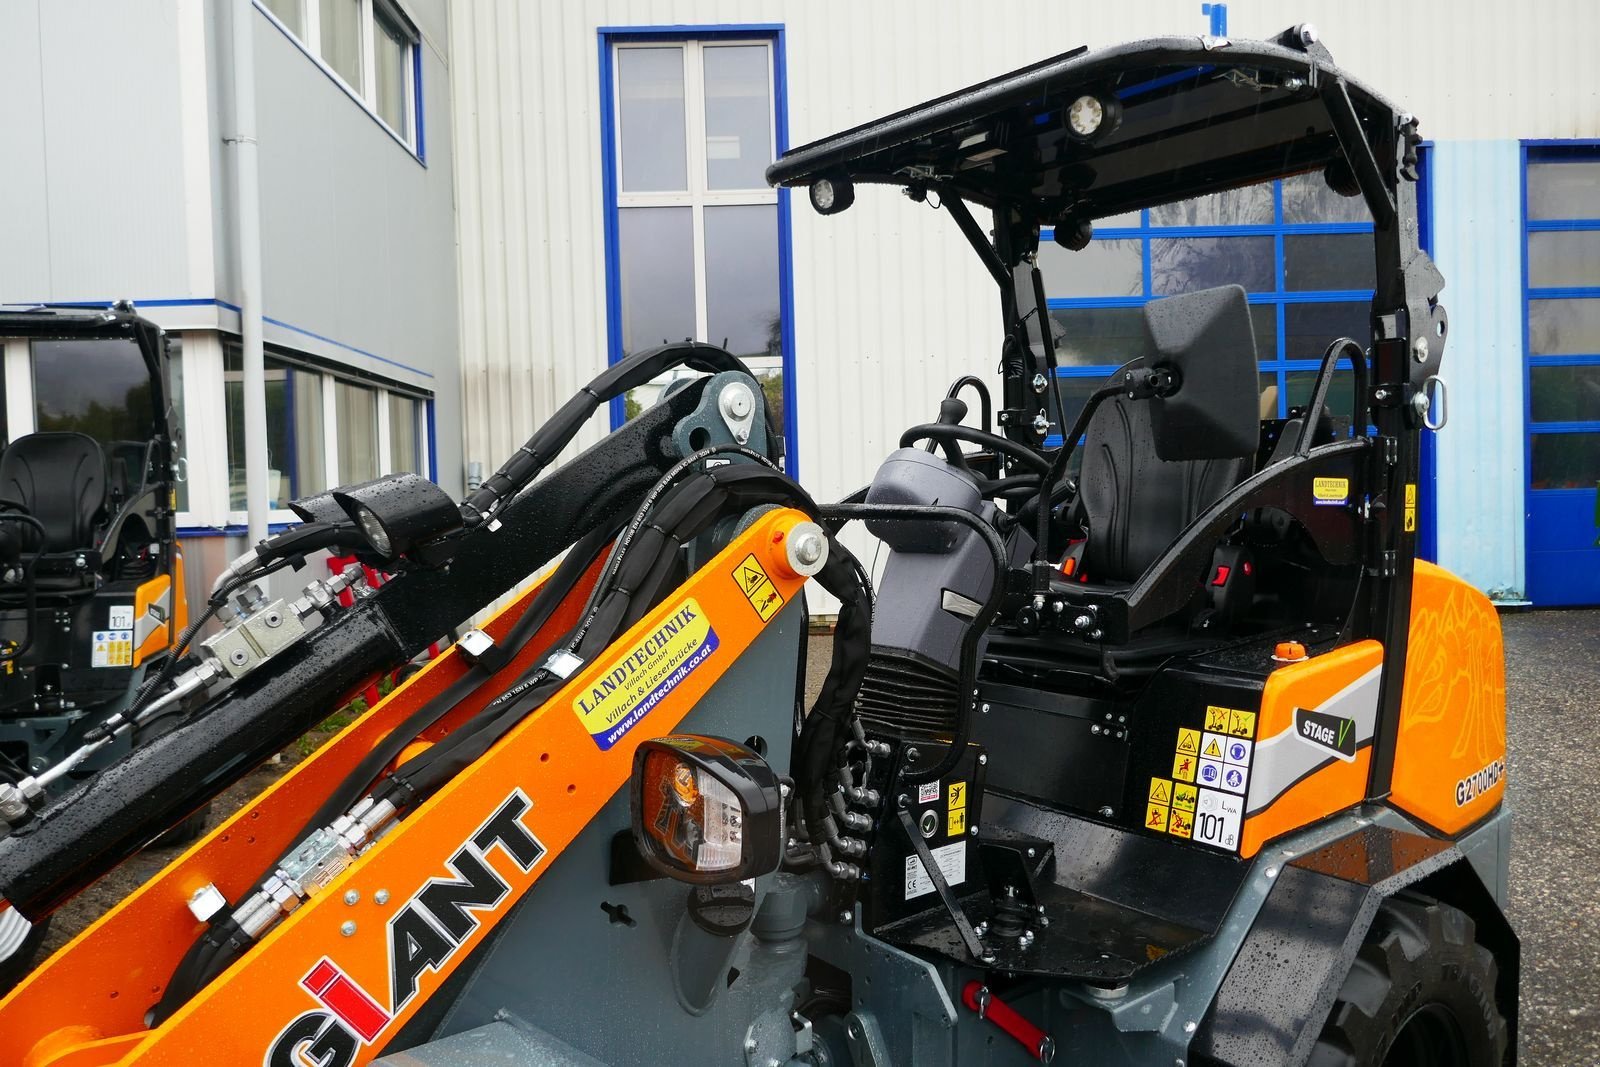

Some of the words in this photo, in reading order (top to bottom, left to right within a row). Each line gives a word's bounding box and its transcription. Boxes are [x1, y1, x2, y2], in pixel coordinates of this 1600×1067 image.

[112, 616, 125, 627] 101
[578, 605, 697, 716] LANDTECHNIK
[605, 693, 637, 724] Villach
[638, 686, 645, 696] &
[645, 638, 698, 689] Lieserbrücke
[624, 668, 648, 691] Villach
[647, 649, 668, 670] GmbH
[607, 644, 712, 744] www.landtechnik.co.at
[1303, 719, 1335, 745] STAGE
[1455, 757, 1504, 807] G2700HD+
[1199, 812, 1225, 843] 101
